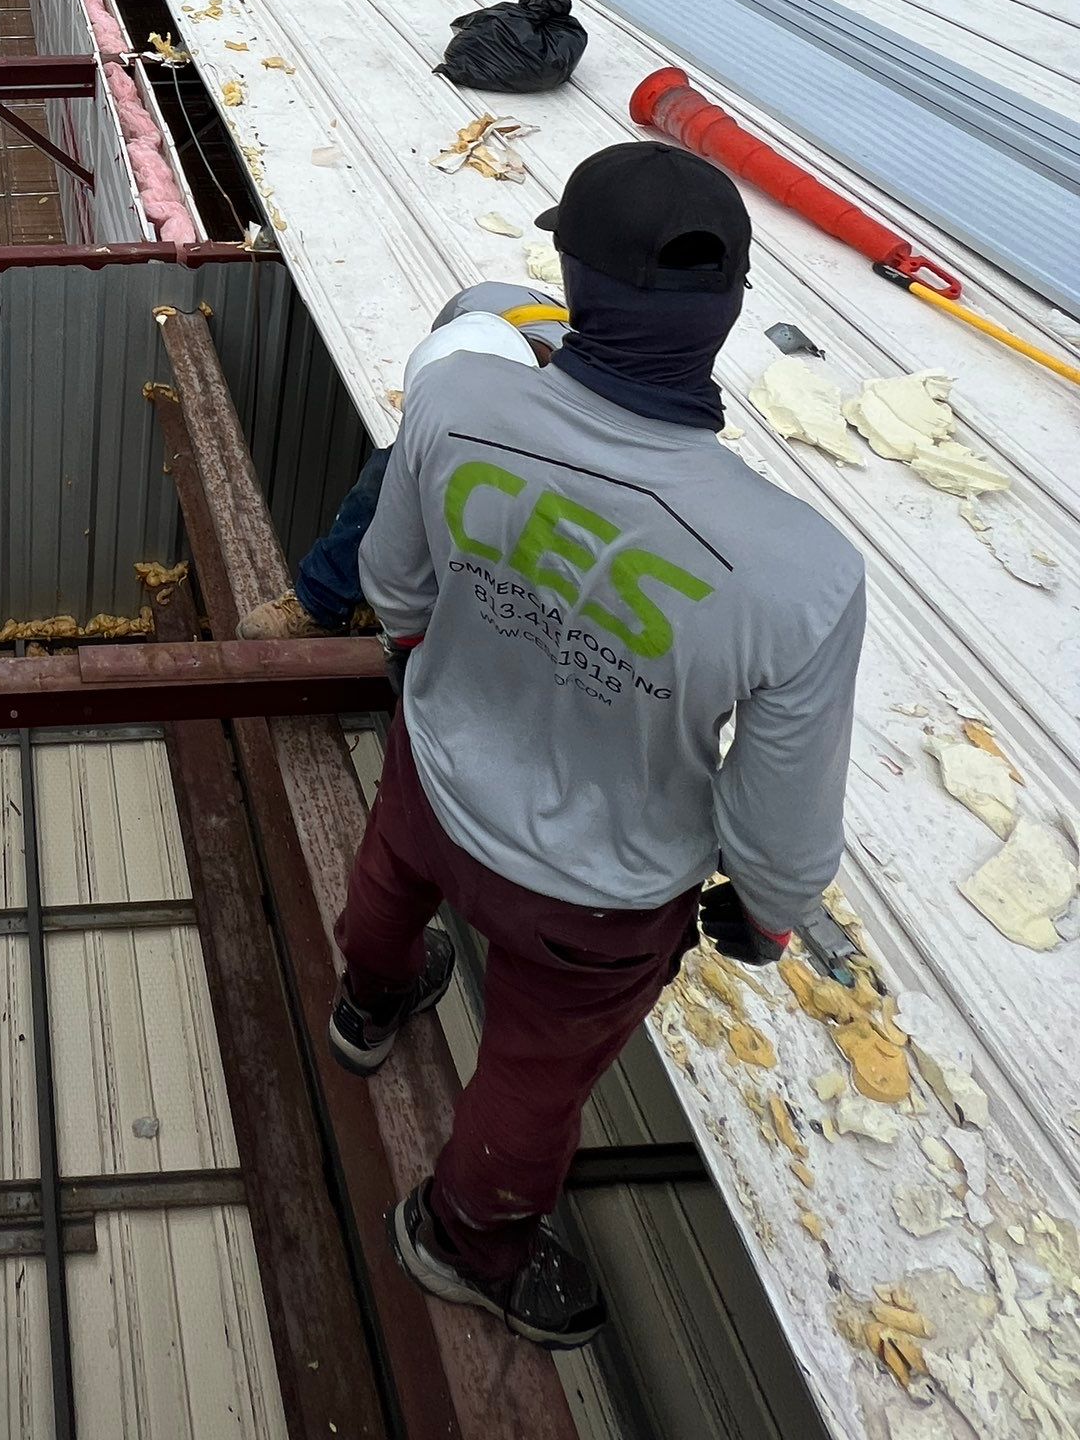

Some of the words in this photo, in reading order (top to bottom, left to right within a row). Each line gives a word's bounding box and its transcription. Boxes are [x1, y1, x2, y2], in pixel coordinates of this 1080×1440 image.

[444, 462, 716, 660] CES
[449, 561, 563, 625] OMMERCIA
[566, 629, 672, 700] ROOFING
